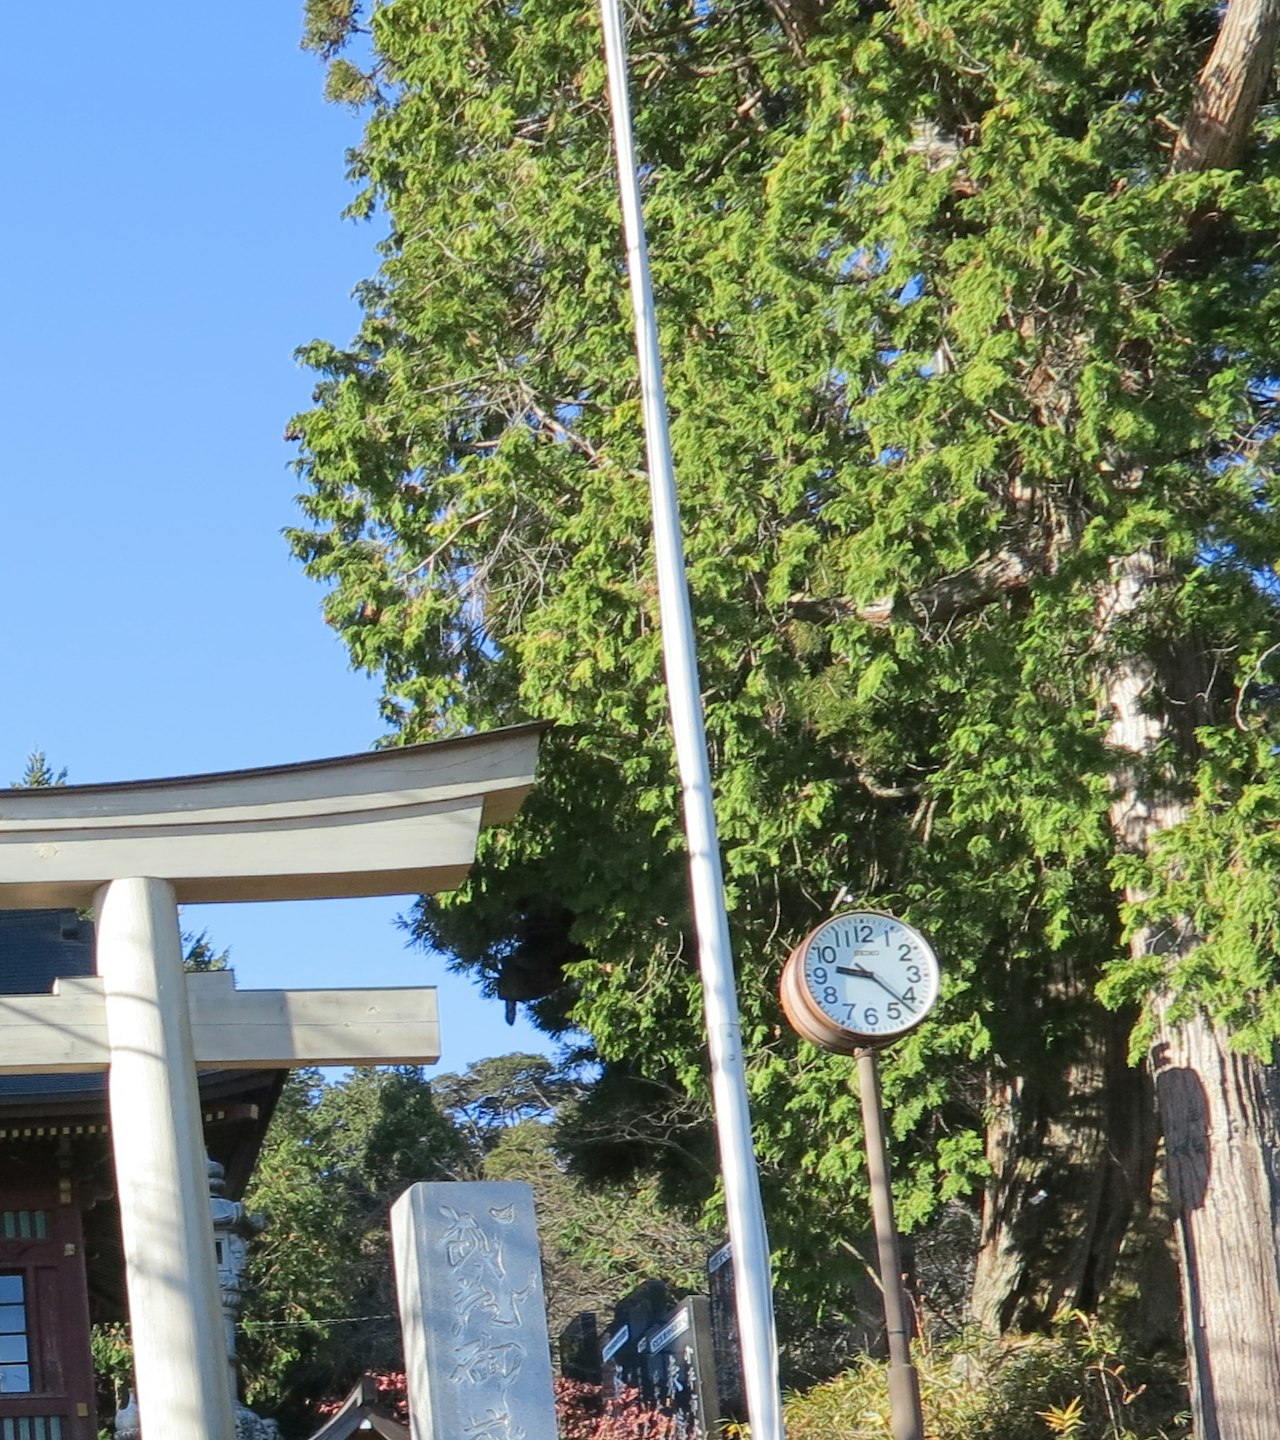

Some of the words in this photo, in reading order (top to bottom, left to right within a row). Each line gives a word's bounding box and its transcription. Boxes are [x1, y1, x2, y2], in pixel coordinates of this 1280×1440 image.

[834, 930, 850, 947] 11
[854, 925, 875, 943] 12
[884, 930, 890, 947] 1
[816, 946, 837, 964] 10
[898, 944, 913, 961] 2
[813, 967, 828, 985] 9
[906, 965, 921, 983] 3
[823, 986, 838, 1004] 8
[902, 986, 917, 1003] 4
[842, 1003, 857, 1020] 7
[864, 1007, 879, 1026] 6
[887, 1002, 901, 1020] 5
